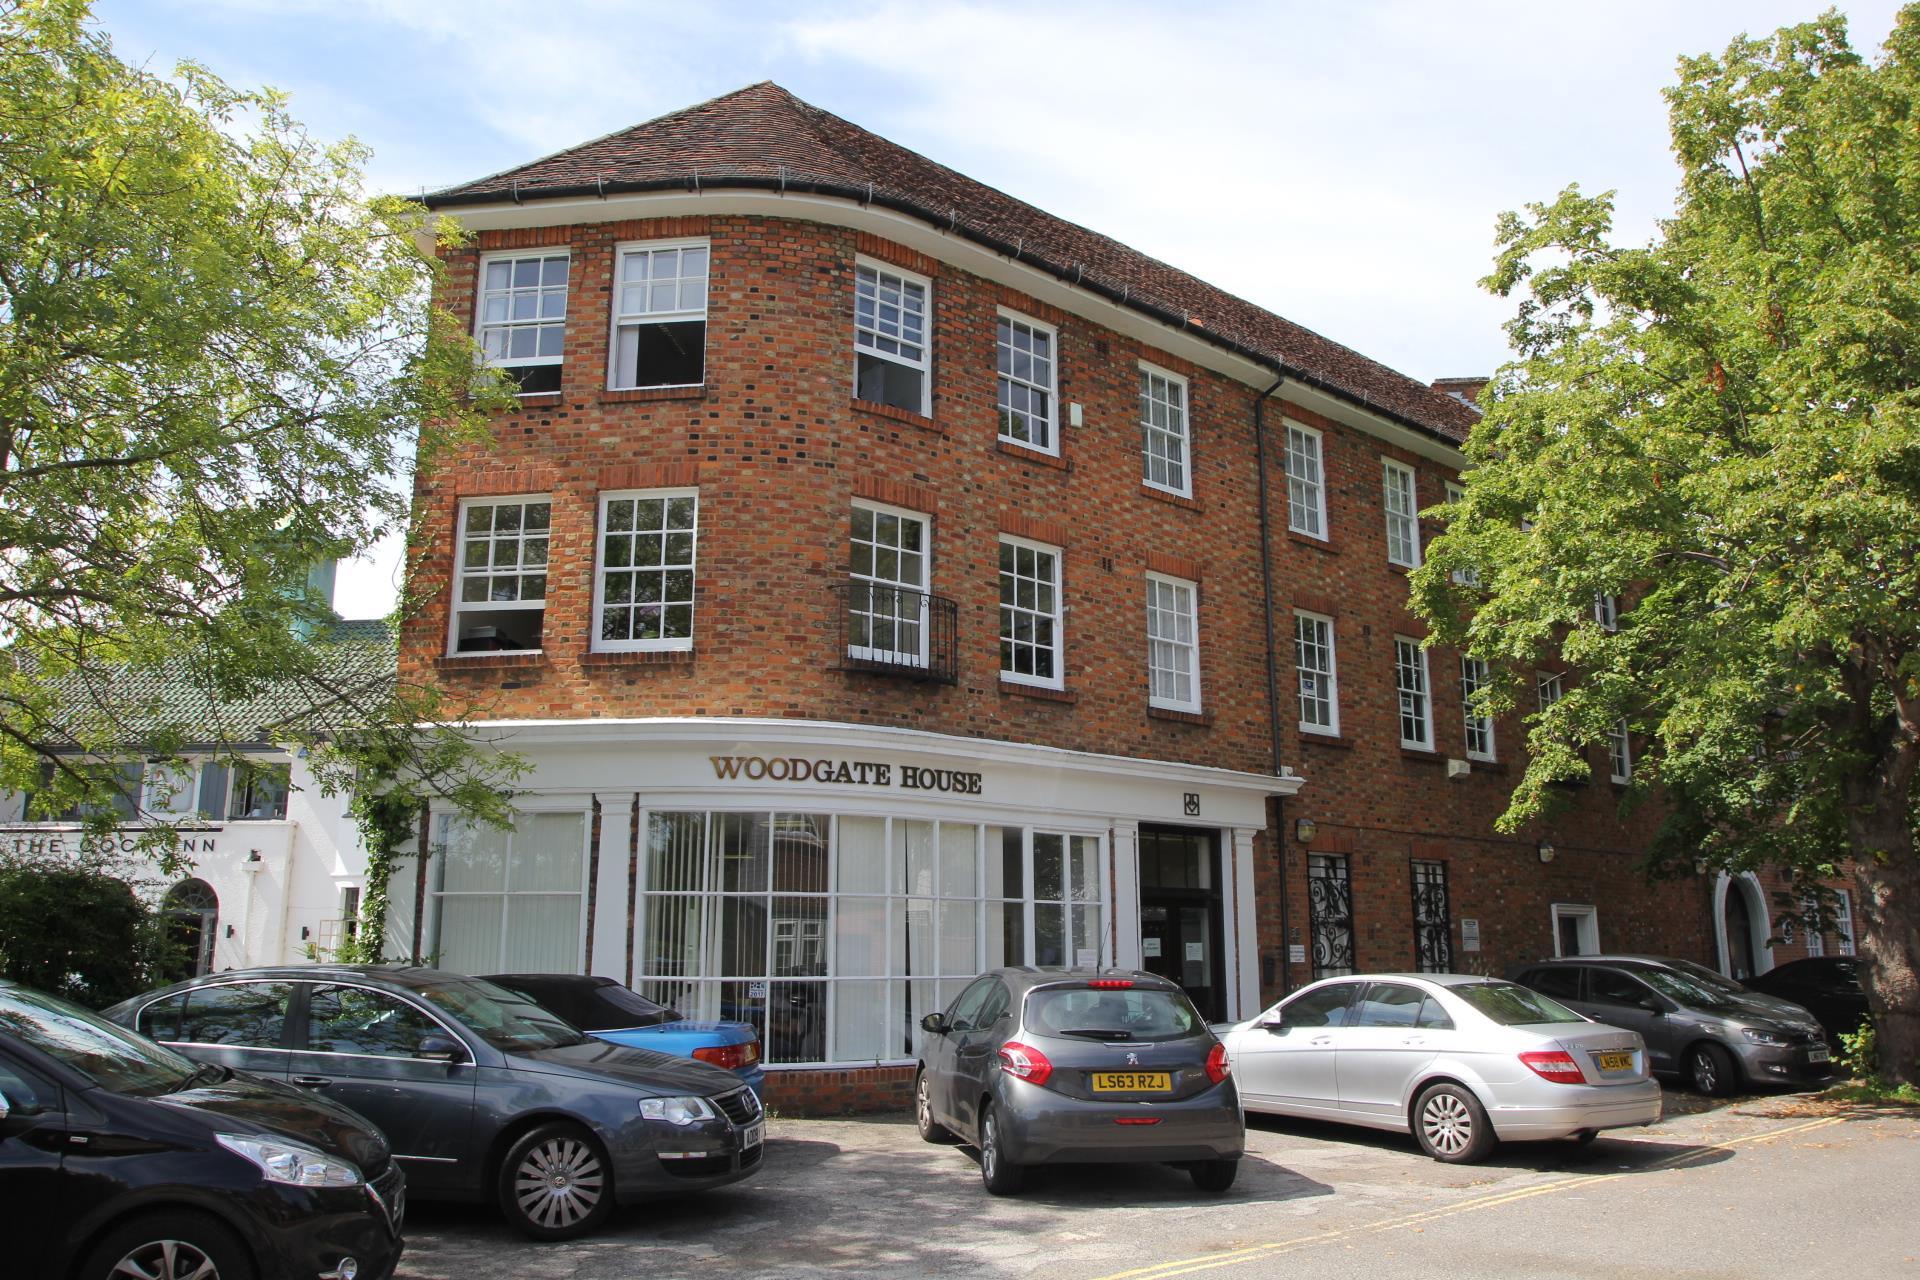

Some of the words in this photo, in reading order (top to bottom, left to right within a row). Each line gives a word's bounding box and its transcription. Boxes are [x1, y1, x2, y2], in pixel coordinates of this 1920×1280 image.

[709, 756, 890, 786] WOODGATE
[900, 765, 982, 795] HOUSE
[13, 839, 63, 853] THE
[79, 838, 148, 853] COC
[1098, 1075, 1135, 1089] LS63
[1138, 1075, 1165, 1089] RZJ
